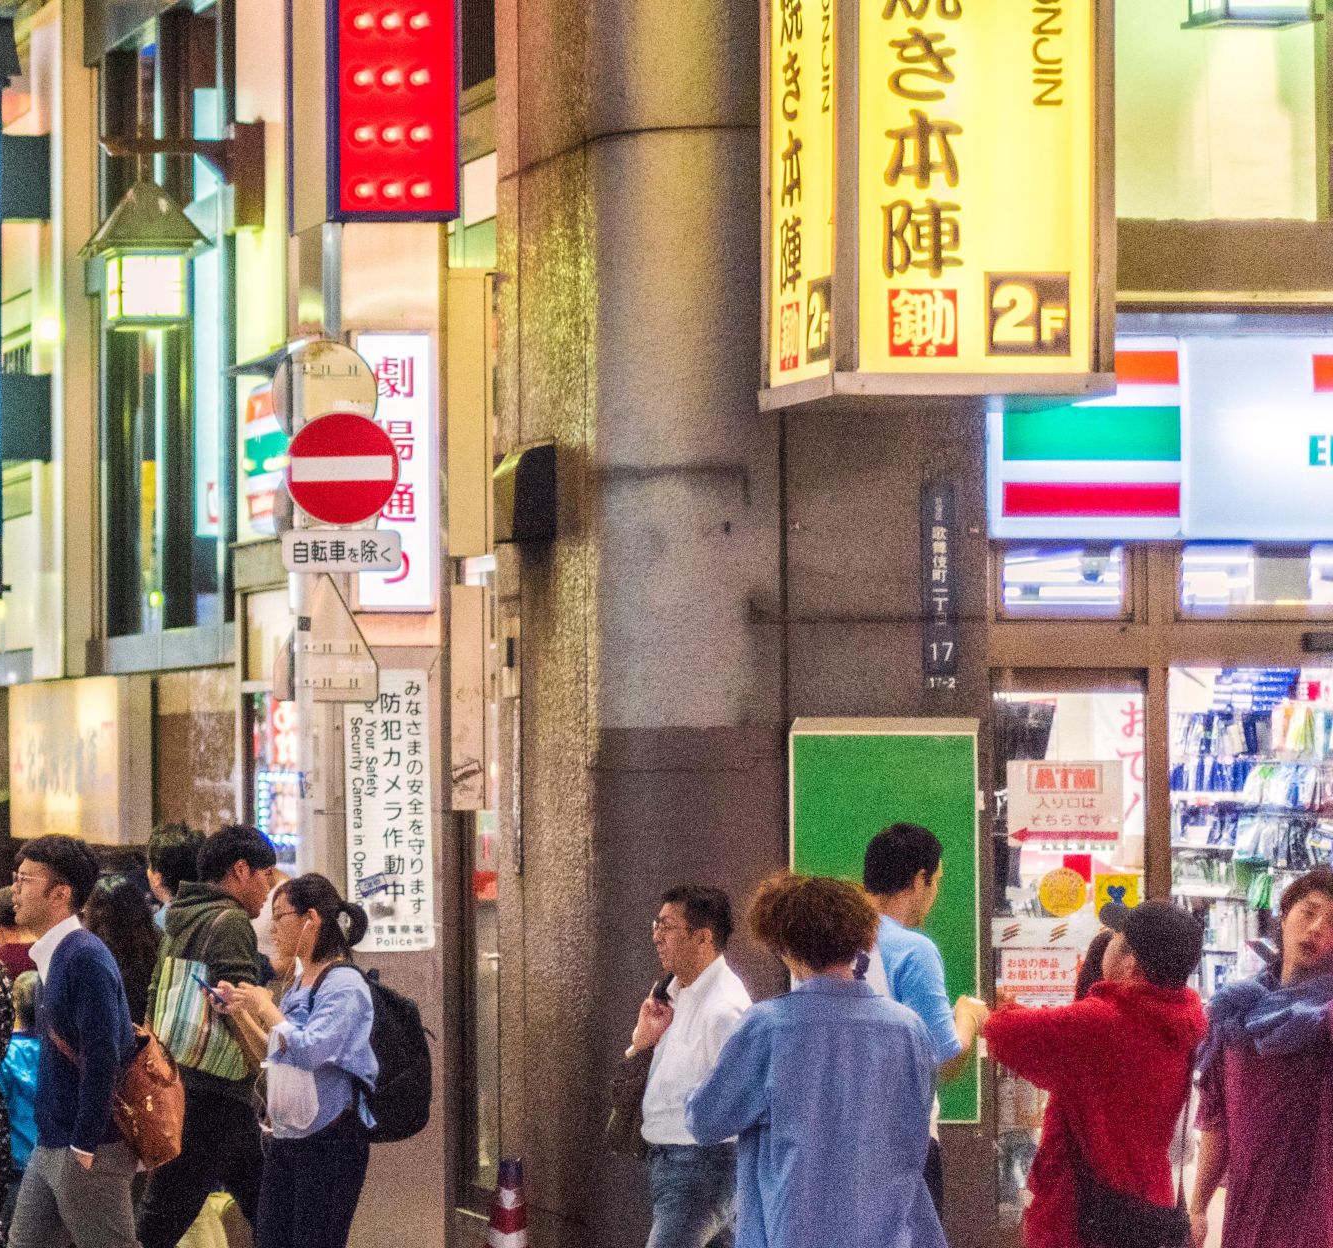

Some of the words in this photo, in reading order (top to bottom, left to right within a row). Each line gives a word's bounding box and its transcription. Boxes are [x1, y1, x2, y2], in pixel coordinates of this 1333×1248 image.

[1031, 0, 1064, 106] NJIN
[808, 292, 831, 350] 2F
[892, 290, 956, 346] 鋤
[990, 283, 1067, 343] 2F
[293, 539, 392, 564] 自転車を除く
[930, 641, 954, 662] 17
[350, 716, 364, 772] Security
[365, 720, 378, 752] Your
[351, 777, 365, 829] Camera
[364, 756, 378, 798] Safety
[380, 692, 406, 904] 防犯カメラ作動中
[403, 680, 428, 915] みなさまの安全を守ります
[1035, 768, 1097, 790] ATM
[353, 834, 364, 846] in
[376, 936, 413, 947] Police
